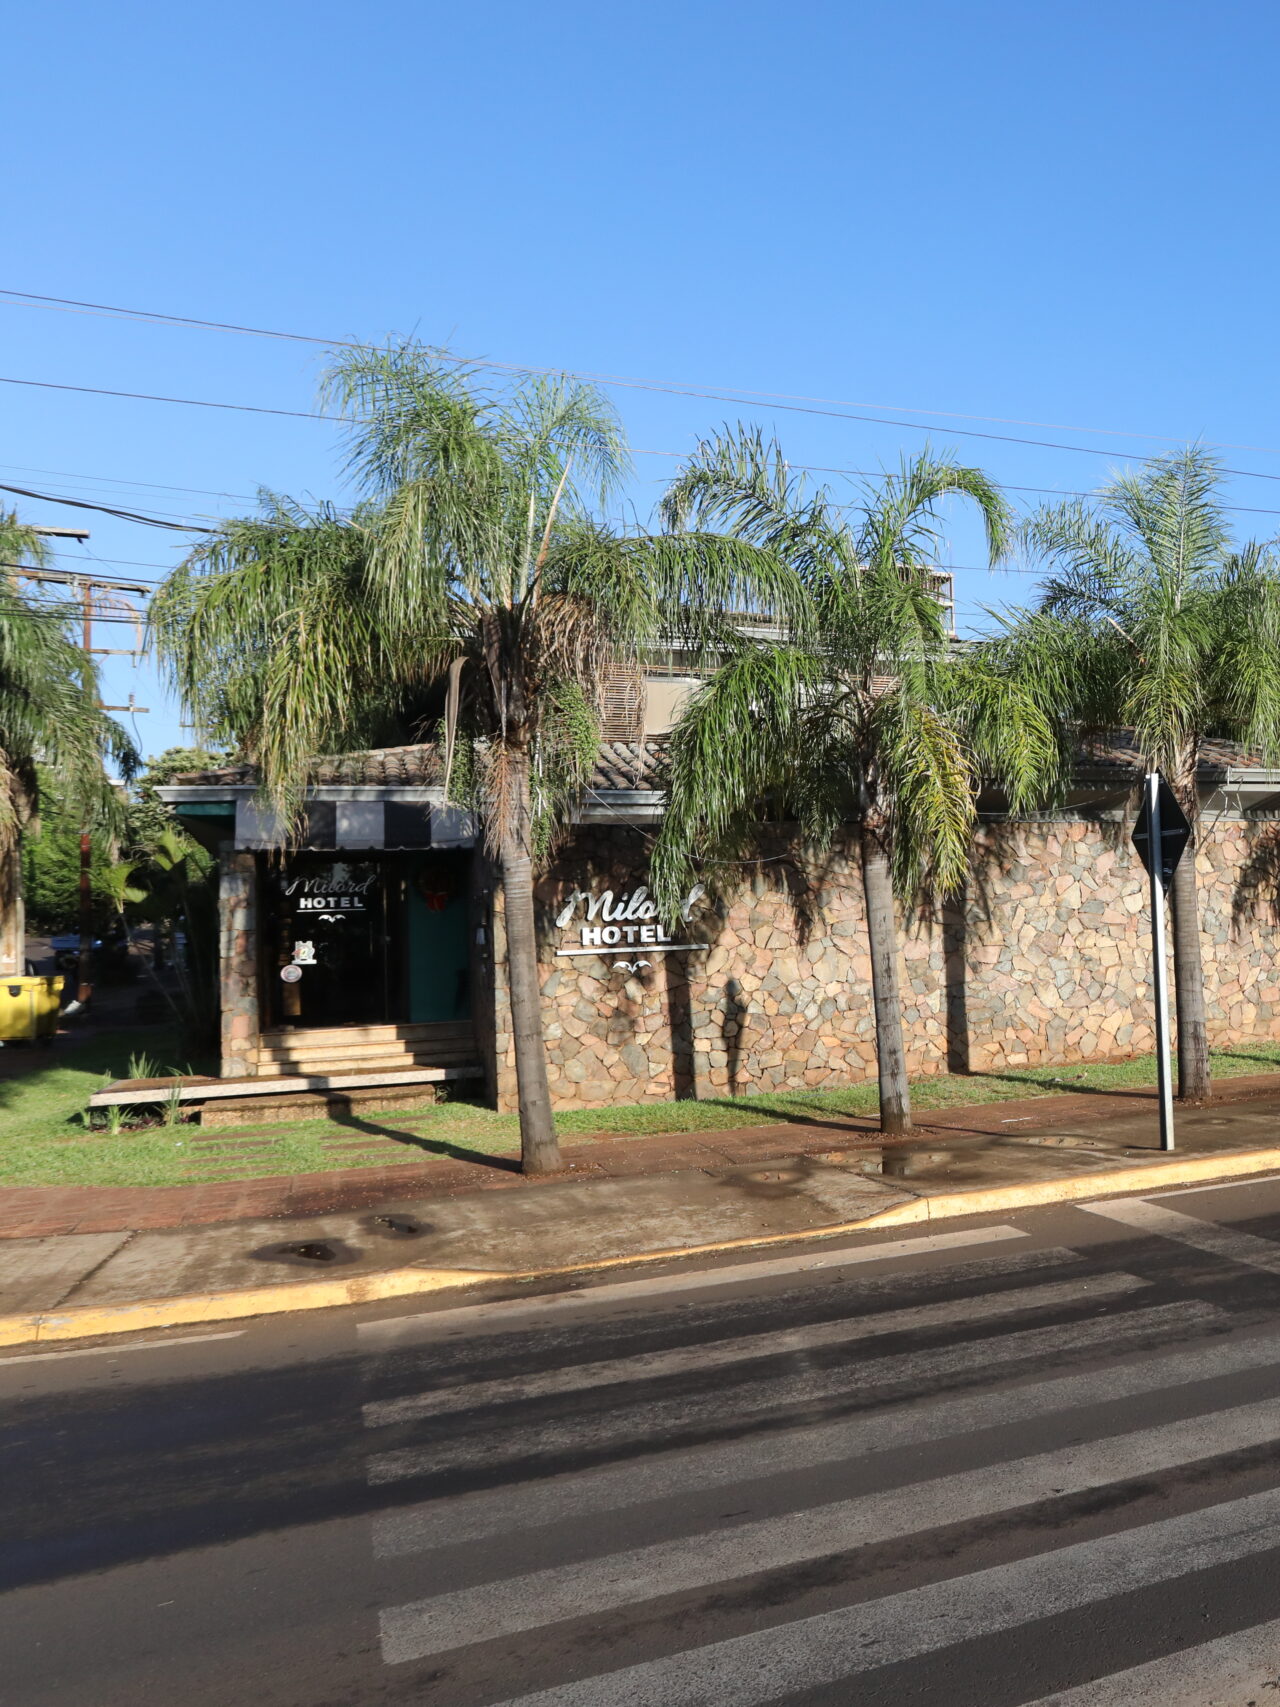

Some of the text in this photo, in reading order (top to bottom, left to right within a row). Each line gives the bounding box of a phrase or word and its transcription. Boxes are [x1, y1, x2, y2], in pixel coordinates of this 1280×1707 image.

[285, 874, 376, 895] Milord
[300, 897, 363, 908] HOTEL
[555, 883, 706, 927] Milod
[582, 925, 672, 946] HOTEL
